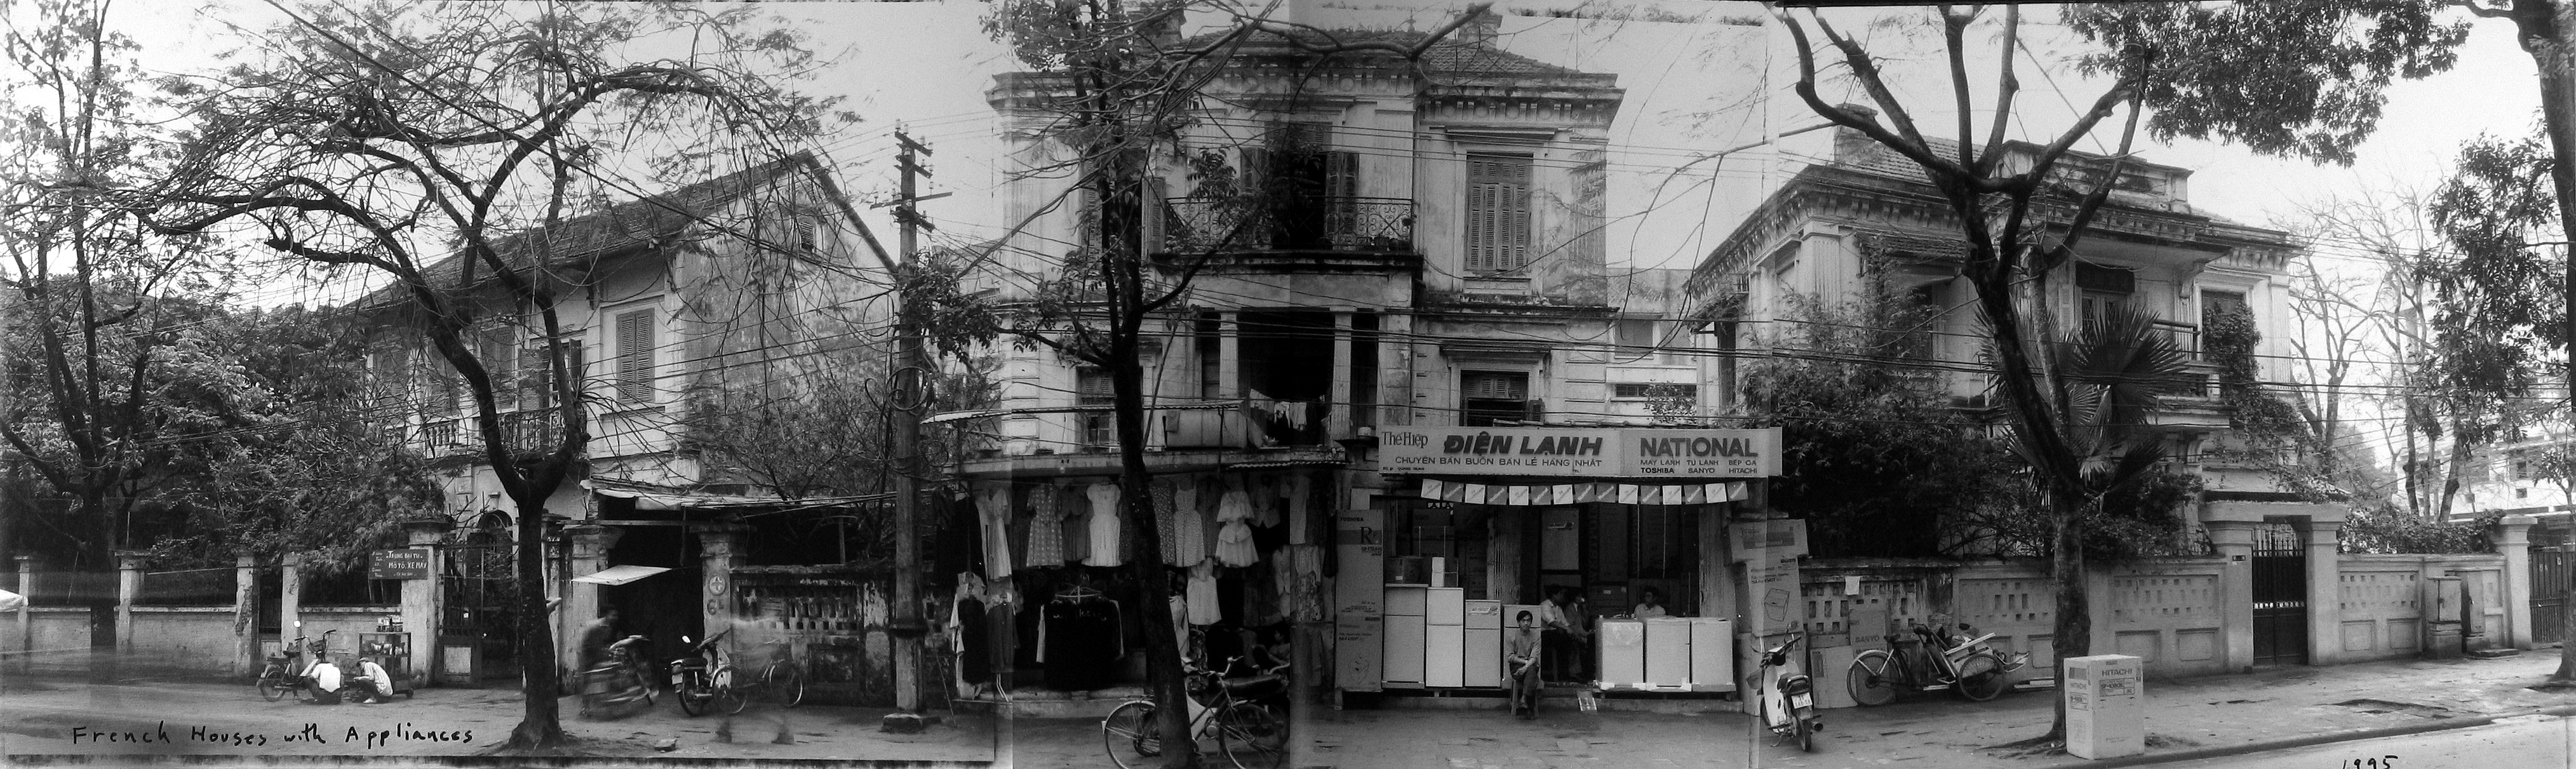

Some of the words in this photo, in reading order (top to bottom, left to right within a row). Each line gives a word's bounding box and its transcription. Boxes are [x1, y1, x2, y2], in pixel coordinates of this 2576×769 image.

[1444, 431, 1513, 456] ĐIỆN
[1520, 436, 1603, 455] LẠNH
[1640, 437, 1758, 457] NATIONAL
[2102, 668, 2133, 676] HITACHI
